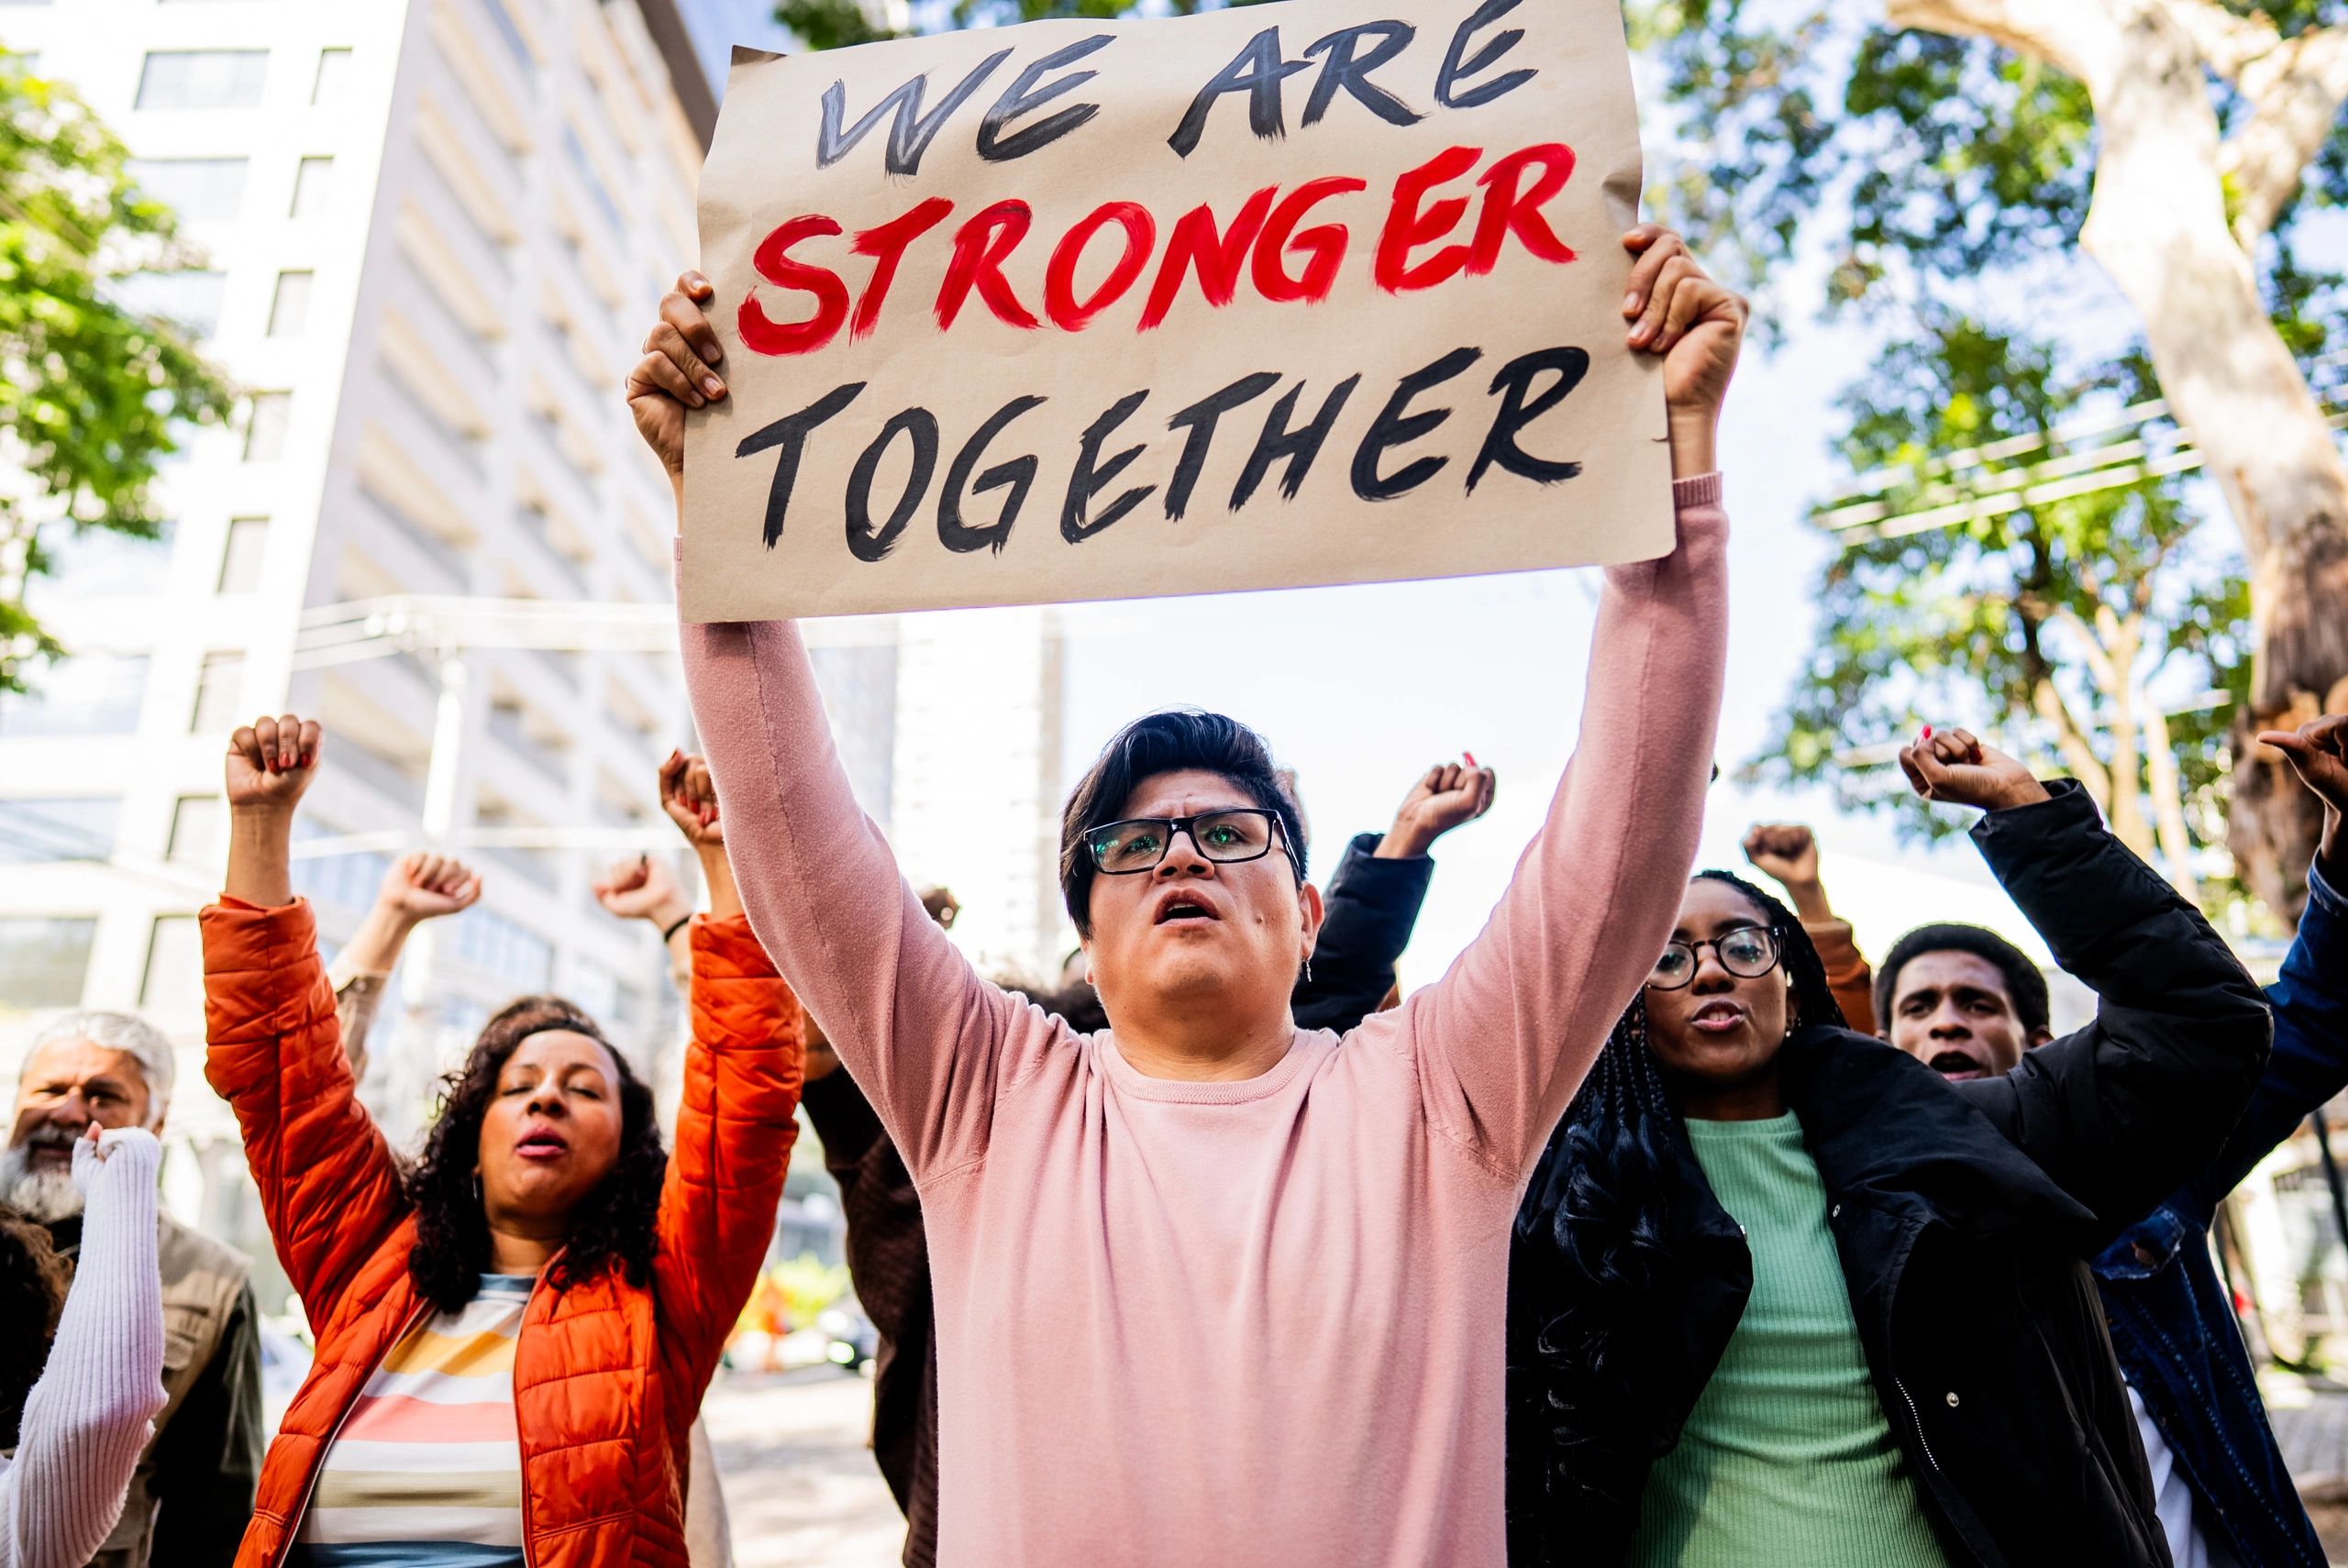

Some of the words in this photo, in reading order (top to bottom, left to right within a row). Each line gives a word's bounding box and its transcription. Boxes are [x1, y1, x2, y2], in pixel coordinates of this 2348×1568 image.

[815, 35, 1116, 177] WE
[1167, 0, 1539, 160] ARE
[737, 141, 1578, 358] STRONGER
[734, 346, 1591, 564] TOGETHER
